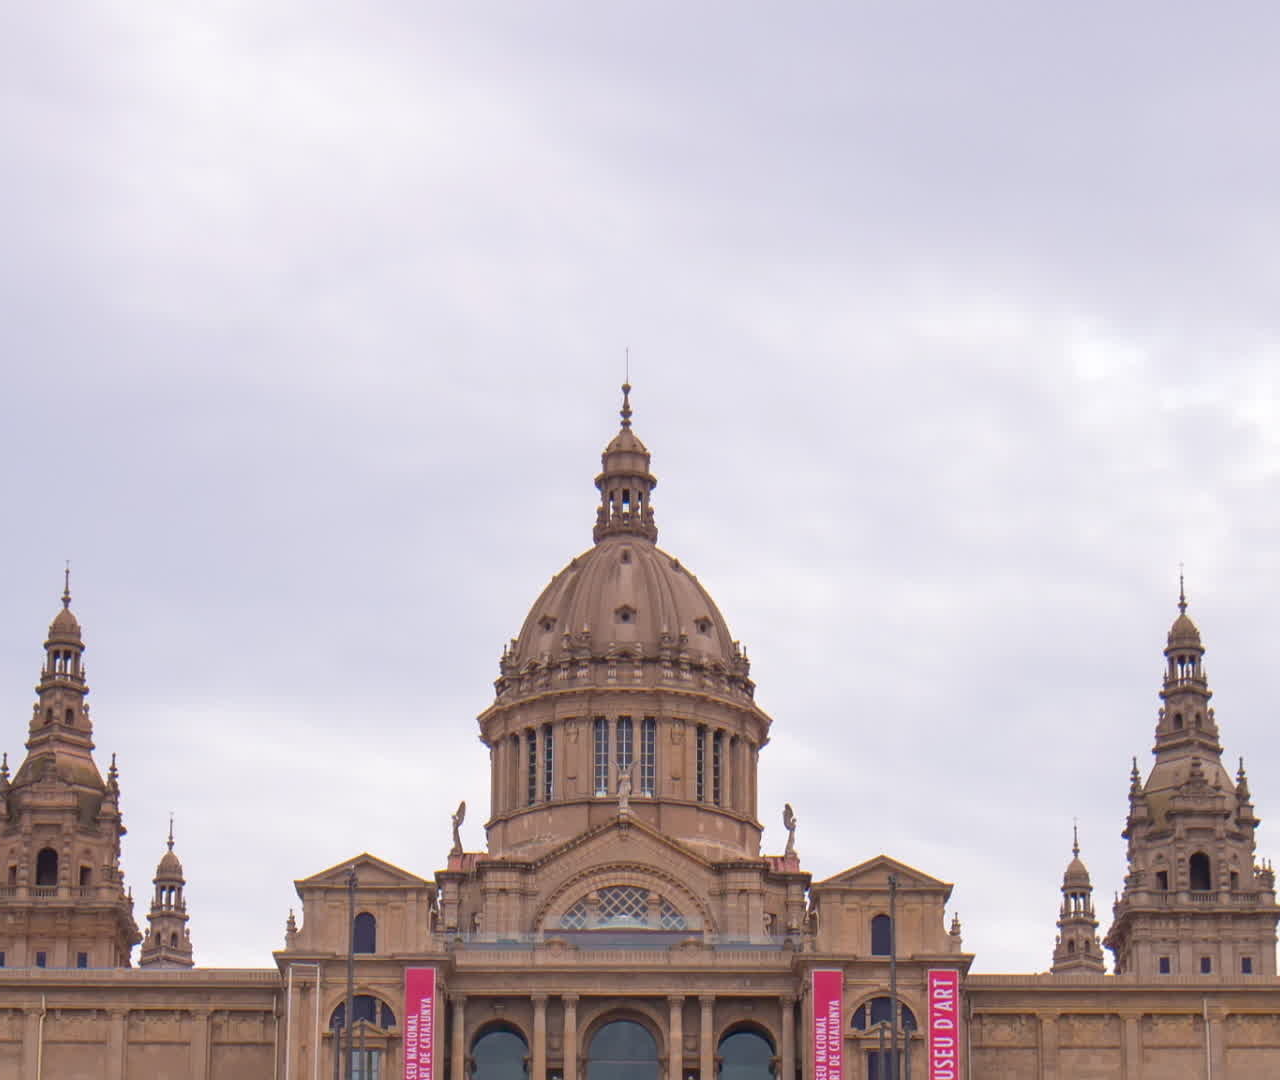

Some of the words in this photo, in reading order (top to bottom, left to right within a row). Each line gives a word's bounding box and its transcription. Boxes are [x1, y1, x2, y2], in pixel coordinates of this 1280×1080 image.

[420, 997, 432, 1049] CATALUNYA
[828, 1000, 840, 1052] CATALUNYA
[933, 978, 954, 1029] D'ART
[407, 1014, 418, 1060] NACIONAL
[419, 1052, 431, 1064] DE
[816, 1016, 827, 1063] NACIONAL
[828, 1054, 840, 1067] DE
